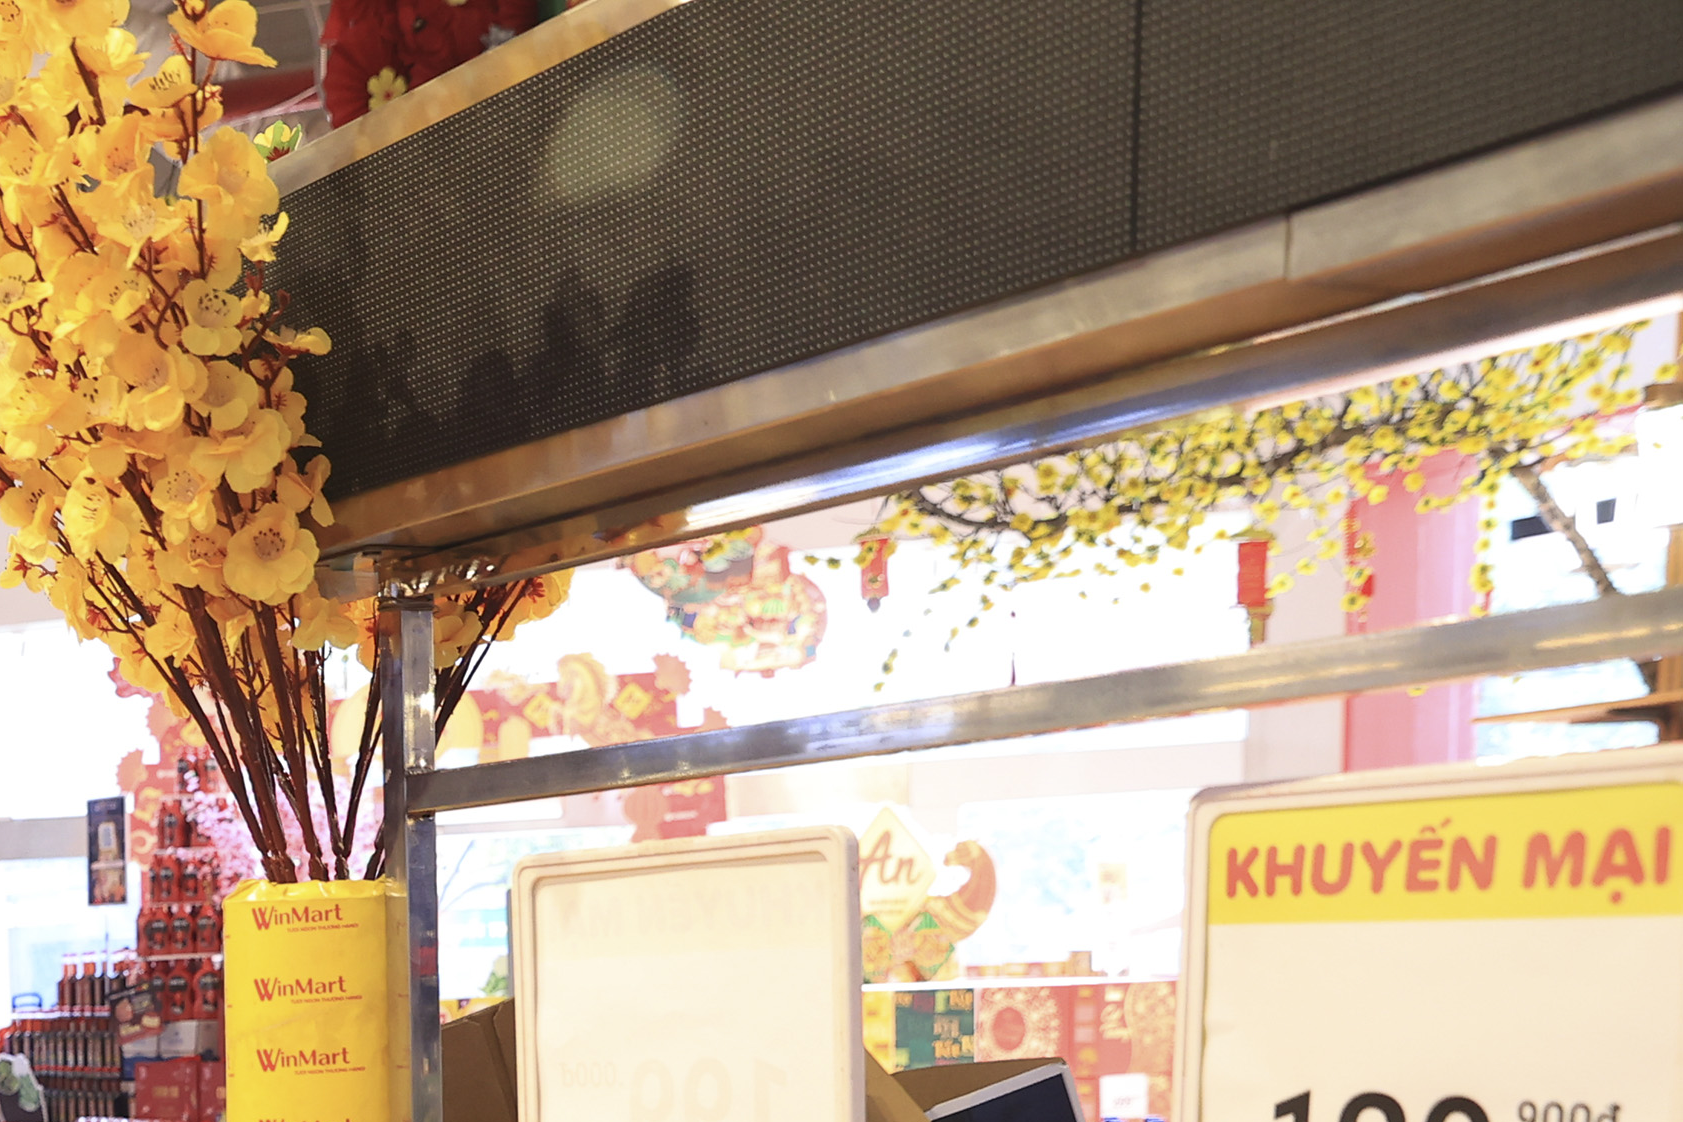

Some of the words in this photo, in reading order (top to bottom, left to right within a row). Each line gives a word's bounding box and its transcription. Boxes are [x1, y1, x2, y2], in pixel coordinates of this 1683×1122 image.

[1226, 818, 1498, 899] KHUYẾN
[1522, 825, 1672, 905] MẠI
[252, 904, 343, 930] WinMart
[254, 976, 347, 1001] WinMart
[257, 1047, 350, 1072] WinMart
